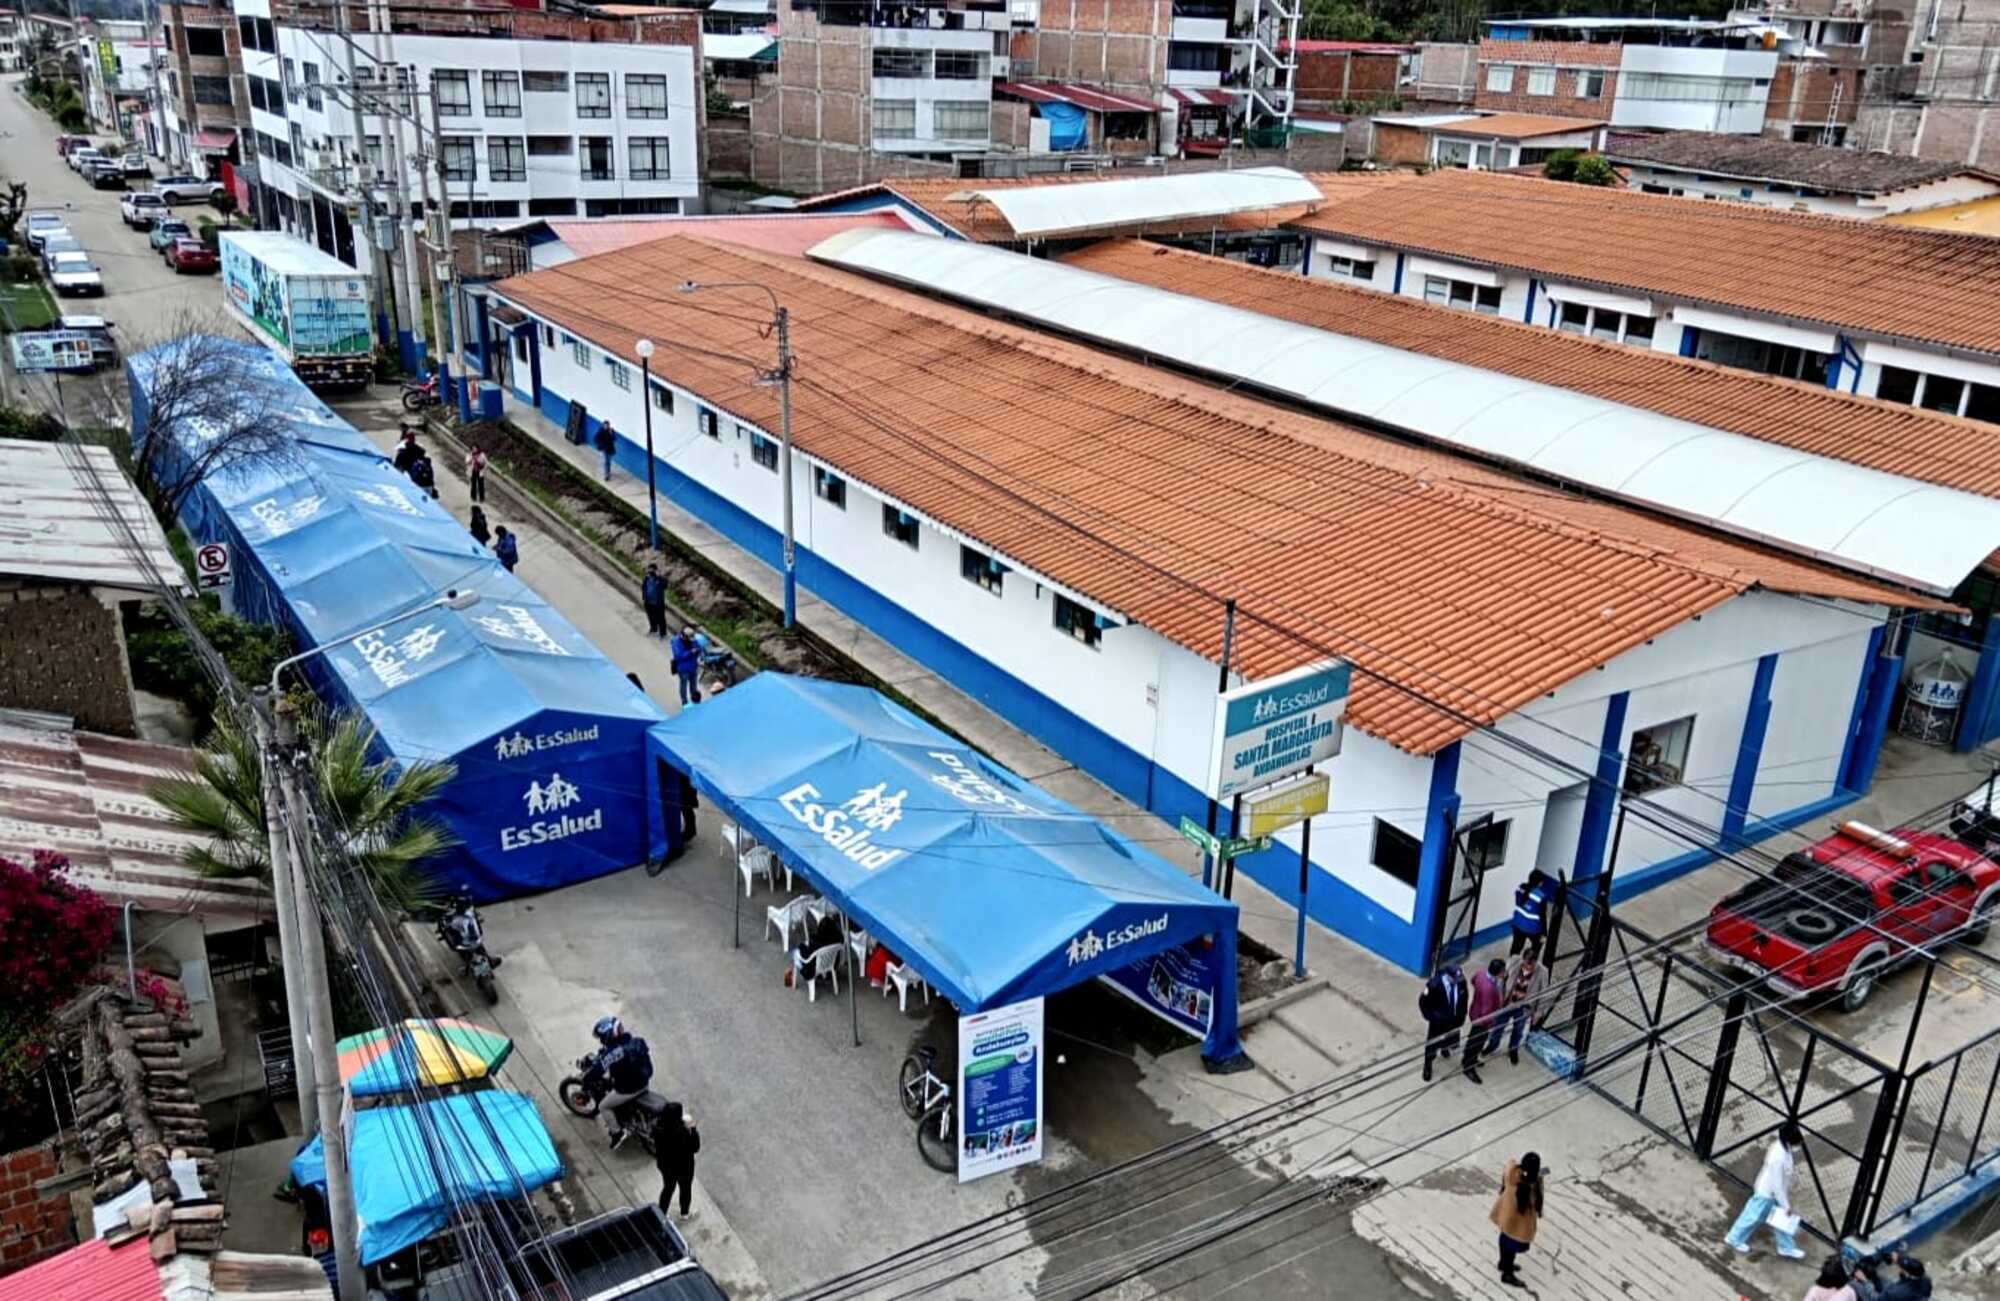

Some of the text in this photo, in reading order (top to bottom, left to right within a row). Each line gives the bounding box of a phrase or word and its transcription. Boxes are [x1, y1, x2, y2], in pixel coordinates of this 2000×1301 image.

[1279, 684, 1328, 714] EsSalud
[535, 723, 600, 750] EsSalud
[1233, 719, 1333, 770] SANTA MARGARITA
[1264, 716, 1308, 741] HOSPITAL
[1252, 745, 1313, 778] ANDAHUAYLAS
[500, 808, 603, 852] EsSalud
[777, 782, 908, 870] EsSalud
[1106, 912, 1169, 950] EsSalud
